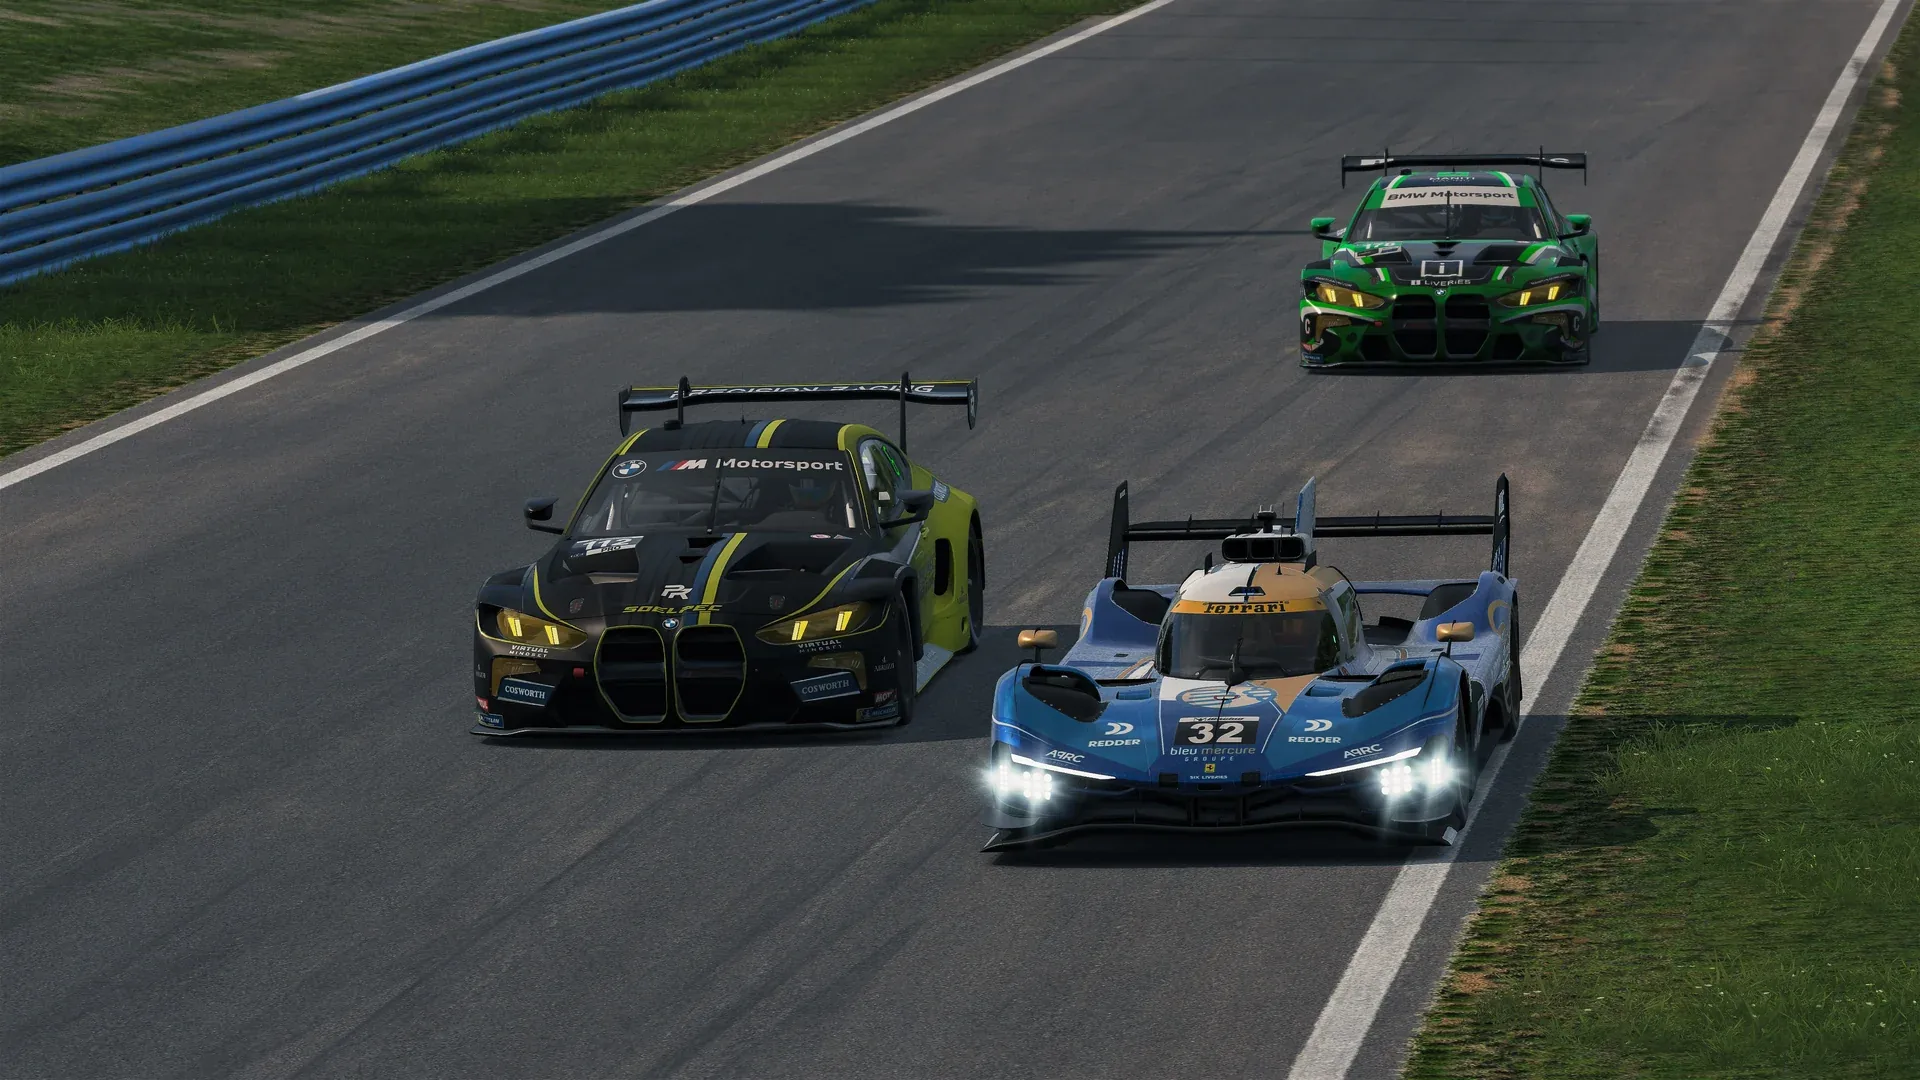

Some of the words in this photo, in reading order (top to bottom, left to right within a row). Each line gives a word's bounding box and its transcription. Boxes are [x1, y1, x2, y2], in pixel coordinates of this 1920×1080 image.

[1387, 191, 1427, 201] BMW
[1430, 190, 1516, 200] Motorsport
[715, 458, 844, 472] Motorsport
[601, 545, 621, 553] PRO
[661, 584, 693, 600] PR
[1203, 600, 1288, 614] Ferrari
[511, 645, 549, 653] VIRTUAL
[798, 639, 842, 649] VIRTUAL
[508, 650, 548, 658] MINDSET
[504, 685, 546, 699] COSWORTH
[801, 679, 850, 695] COSWORTH
[1188, 722, 1245, 744] 32
[1087, 739, 1141, 748] REDDER
[1288, 736, 1342, 744] REDDER
[1170, 747, 1198, 756] bleu
[1201, 747, 1256, 755] mercure
